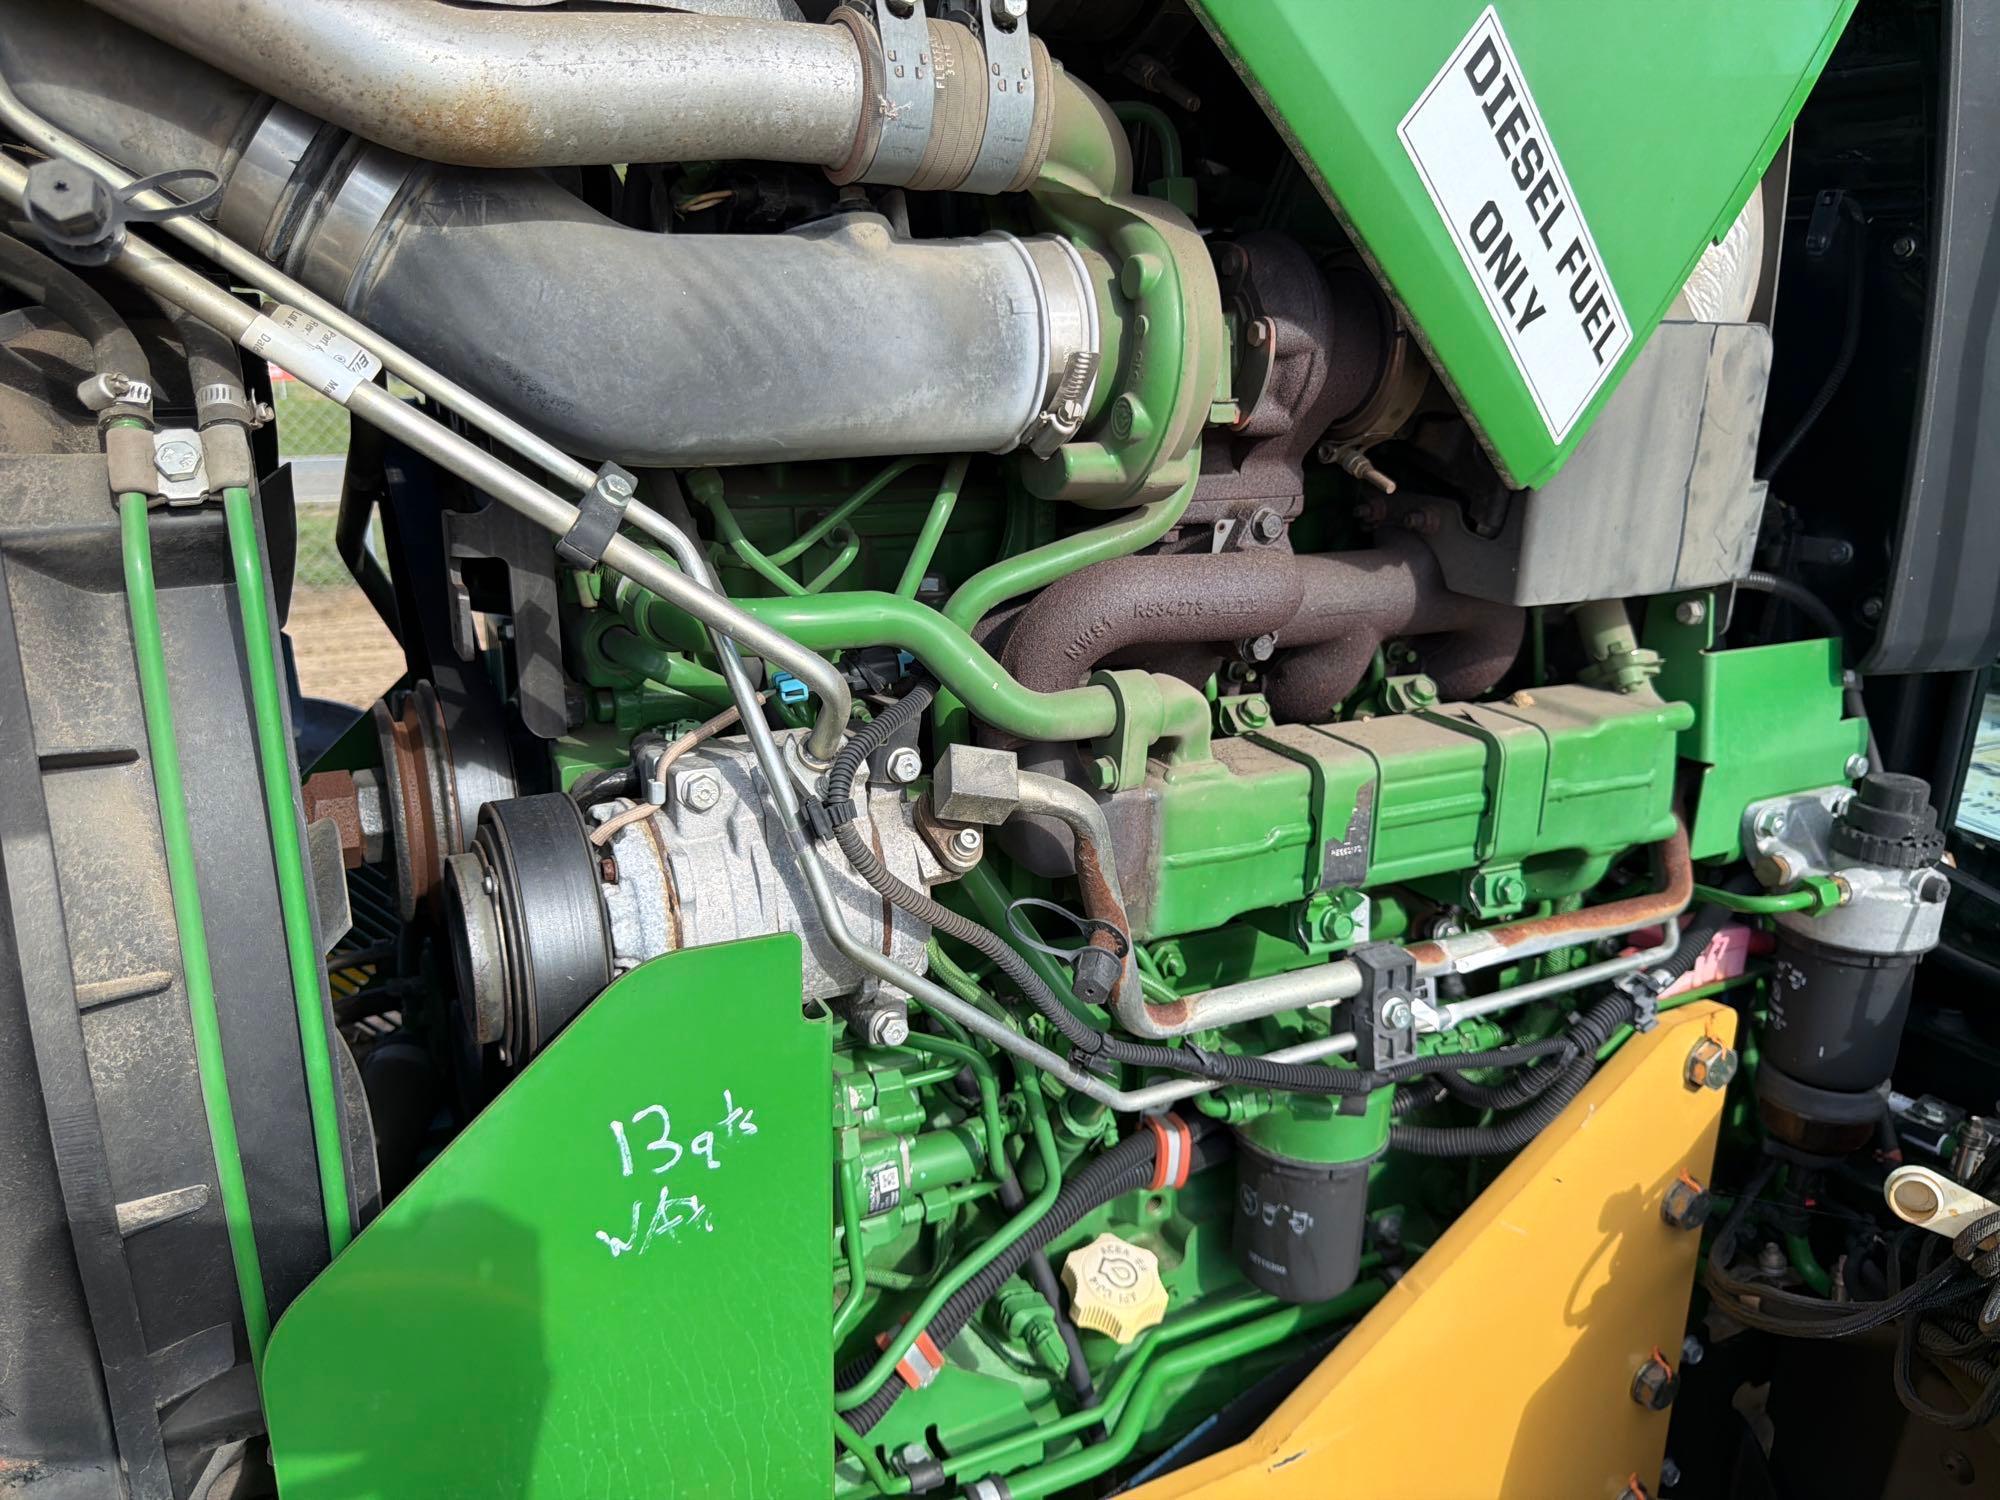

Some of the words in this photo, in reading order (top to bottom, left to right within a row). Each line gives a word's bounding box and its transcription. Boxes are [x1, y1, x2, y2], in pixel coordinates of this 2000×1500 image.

[1464, 34, 1565, 252] DIESEL
[1556, 236, 1616, 366] FUEL
[1469, 200, 1547, 334] ONLY
